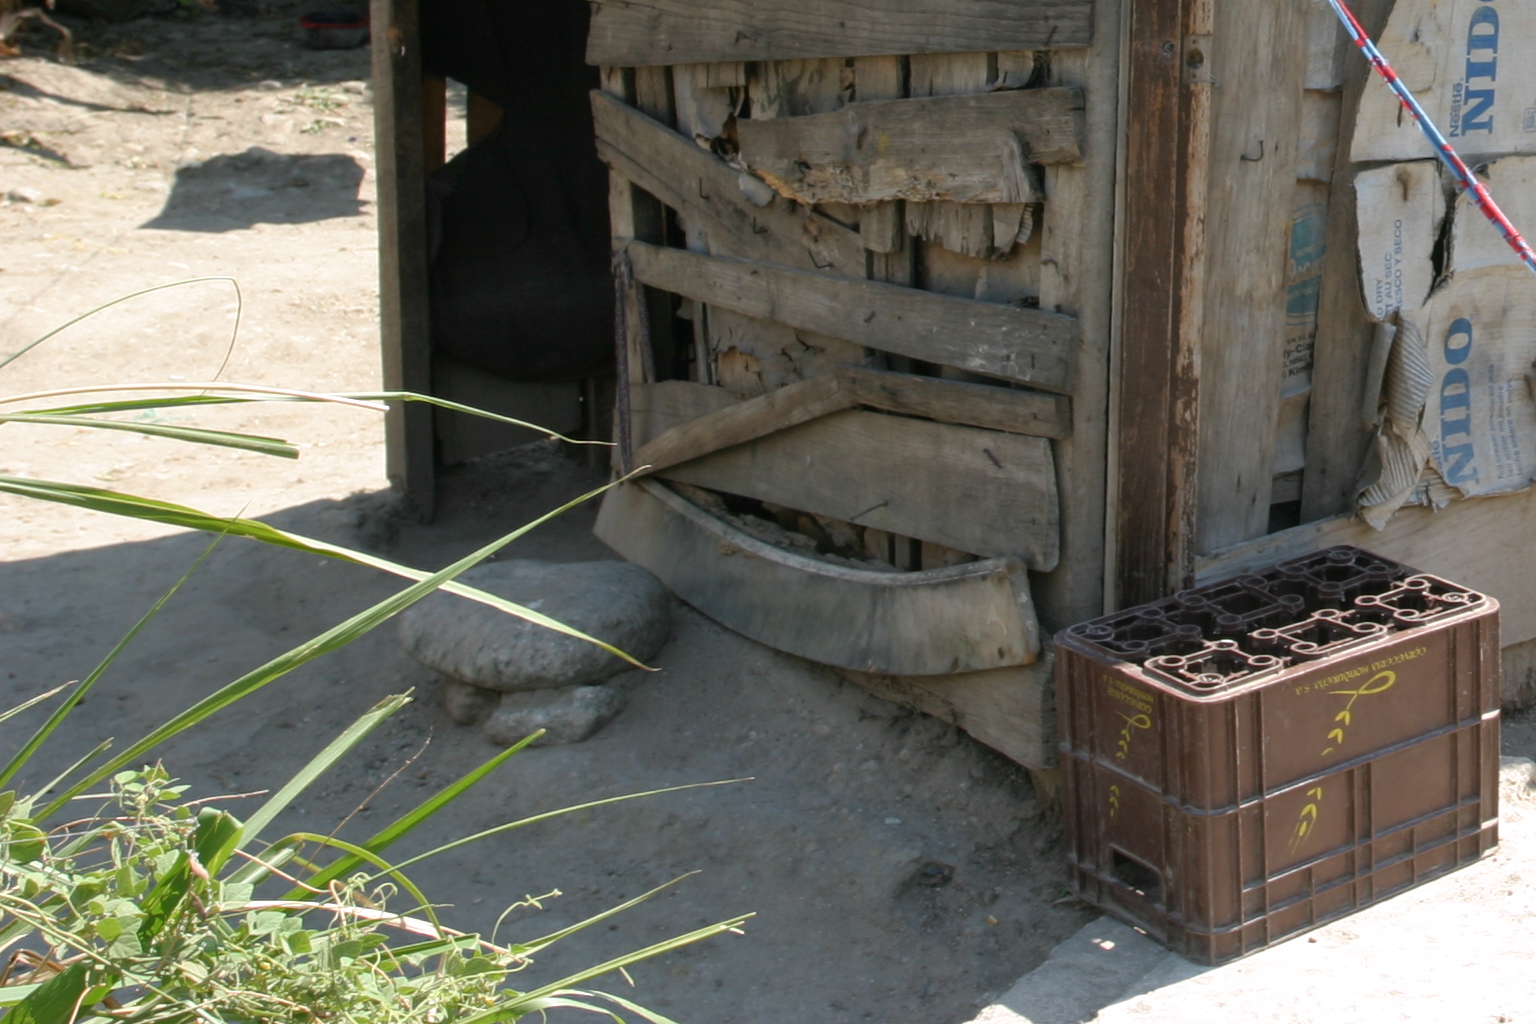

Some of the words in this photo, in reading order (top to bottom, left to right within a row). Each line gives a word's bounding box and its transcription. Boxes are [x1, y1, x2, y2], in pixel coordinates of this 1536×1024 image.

[1394, 219, 1402, 255] SECO
[1384, 252, 1392, 279] SEC
[1375, 279, 1384, 304] DRY
[1384, 282, 1392, 298] AU
[1439, 318, 1480, 485] NIDO
